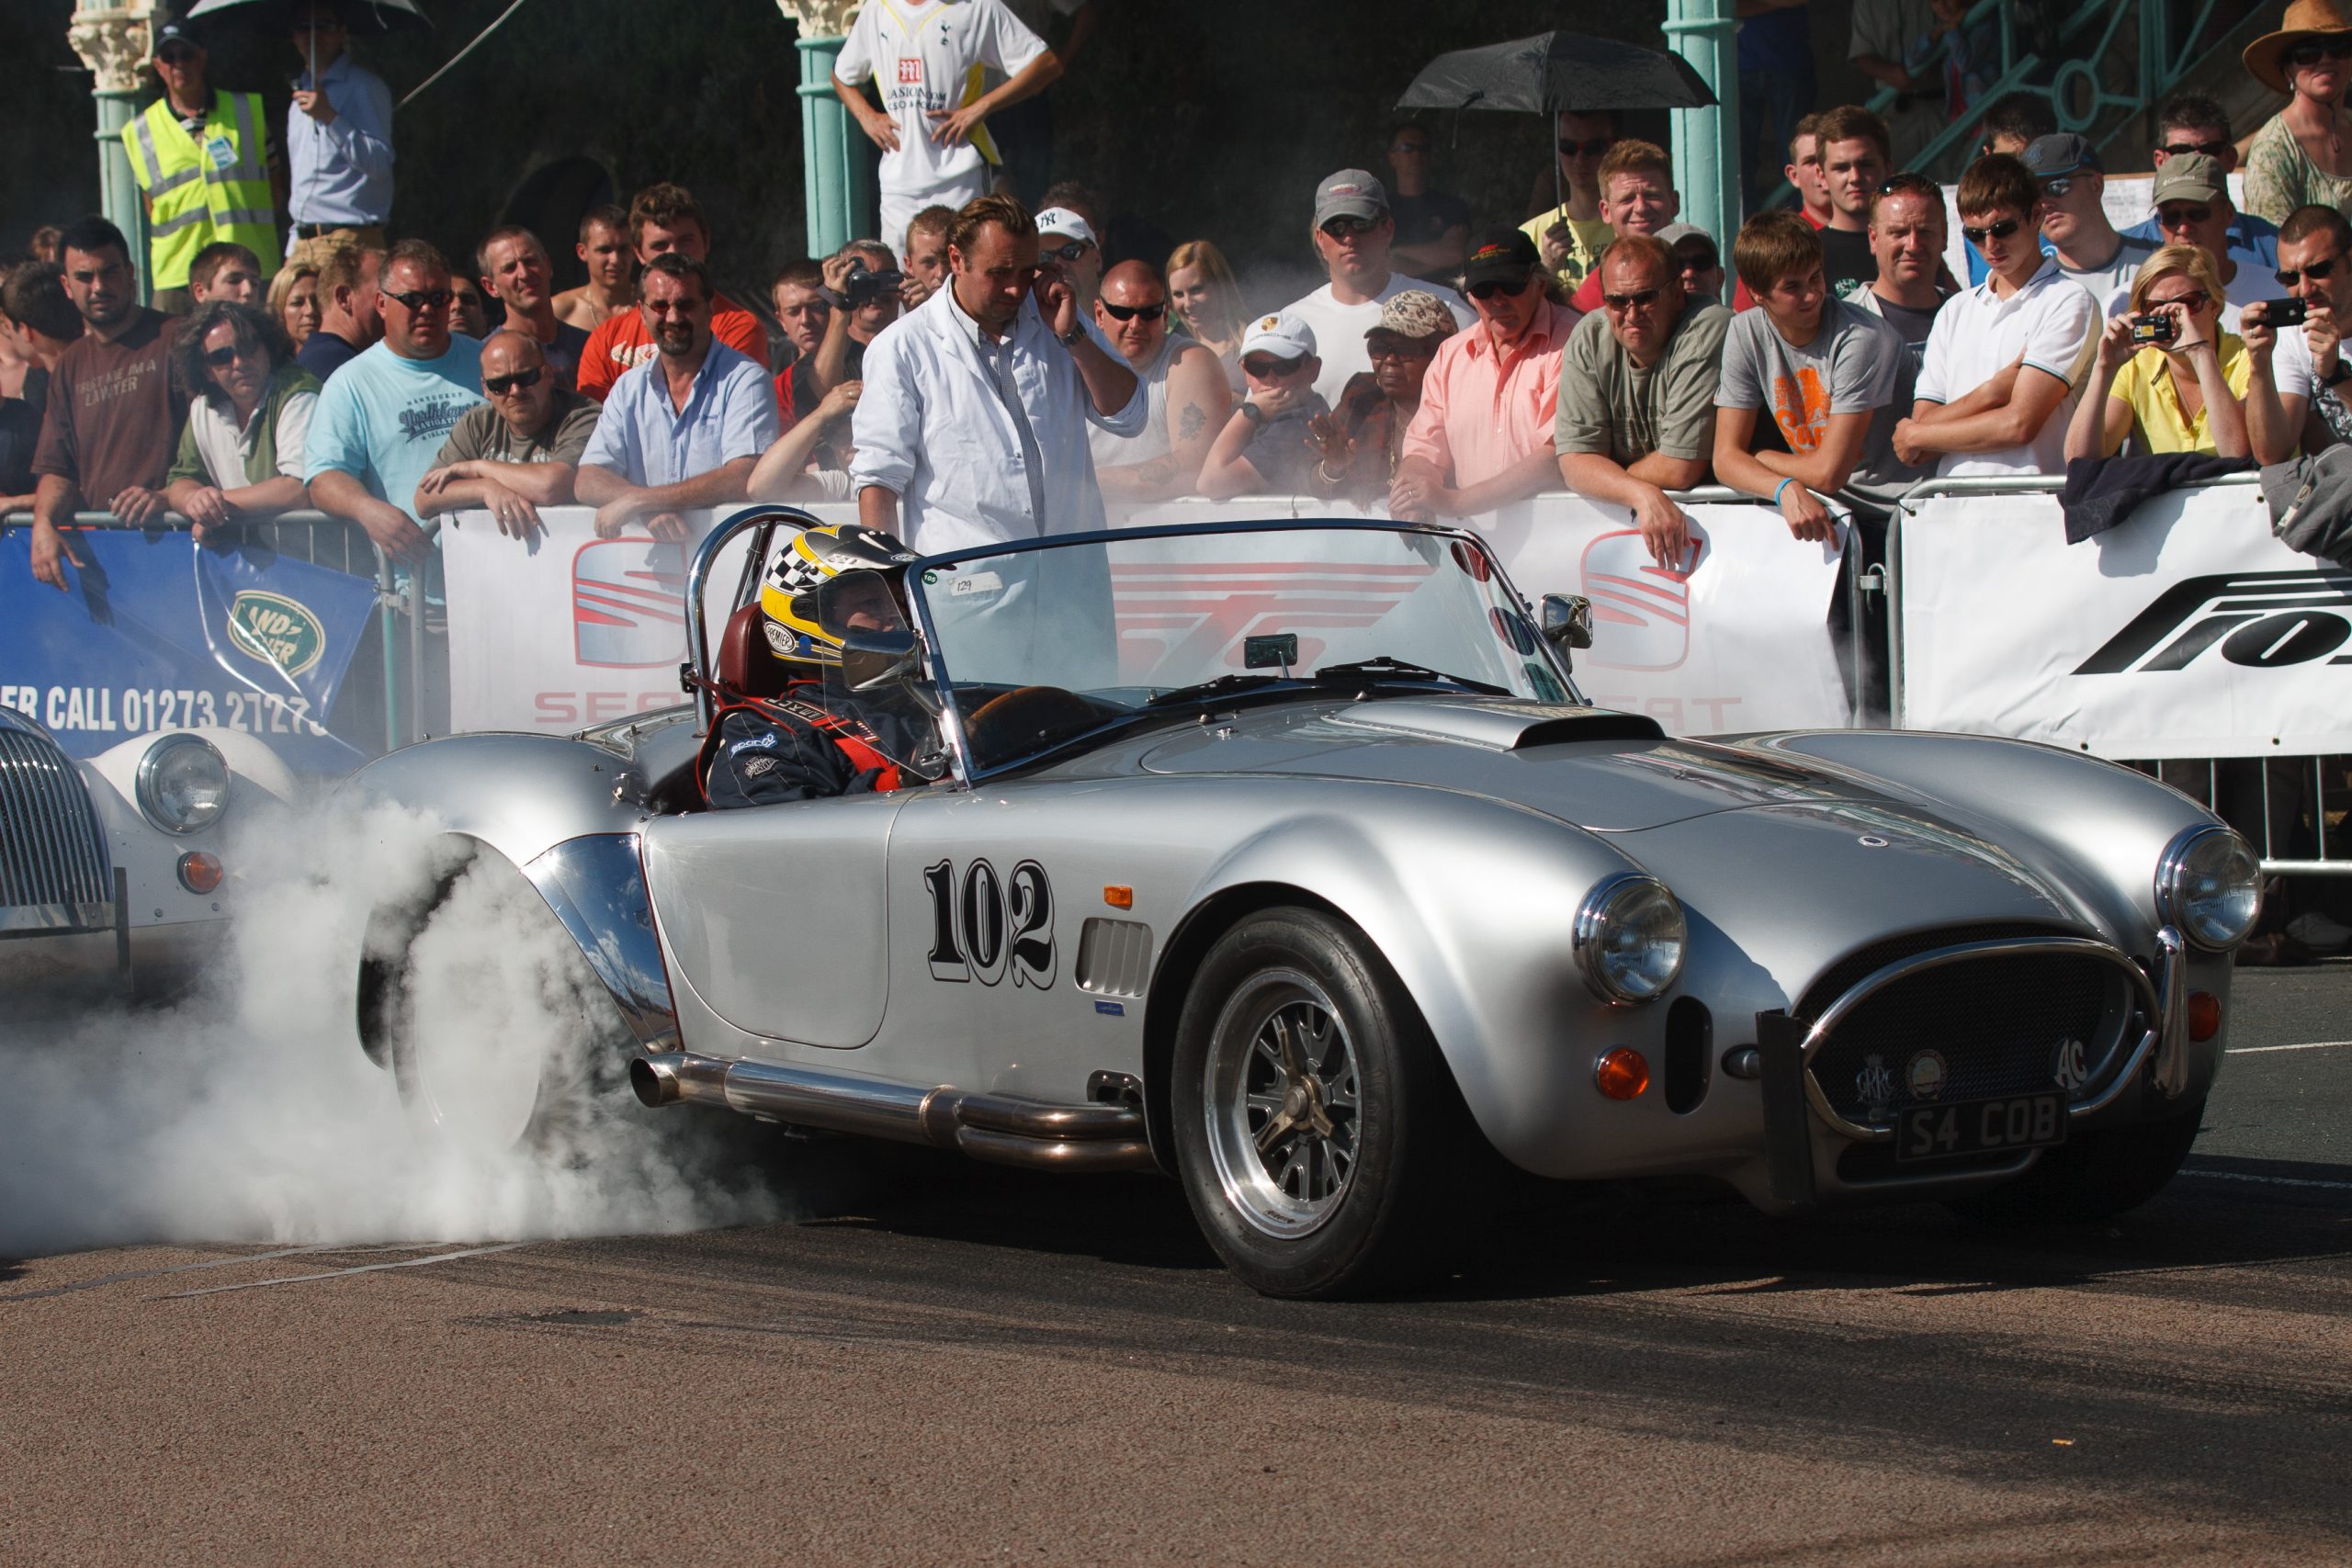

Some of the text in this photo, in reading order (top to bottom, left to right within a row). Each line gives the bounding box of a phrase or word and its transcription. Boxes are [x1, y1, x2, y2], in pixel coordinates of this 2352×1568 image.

[85, 377, 138, 406] LAWYER
[957, 580, 972, 592] 129
[766, 626, 794, 649] PREMIER
[47, 686, 117, 731] CALL
[123, 688, 219, 732] 01273
[923, 857, 1057, 991] 102
[2054, 1037, 2088, 1090] AC
[1910, 1095, 2058, 1156] S4 COB
